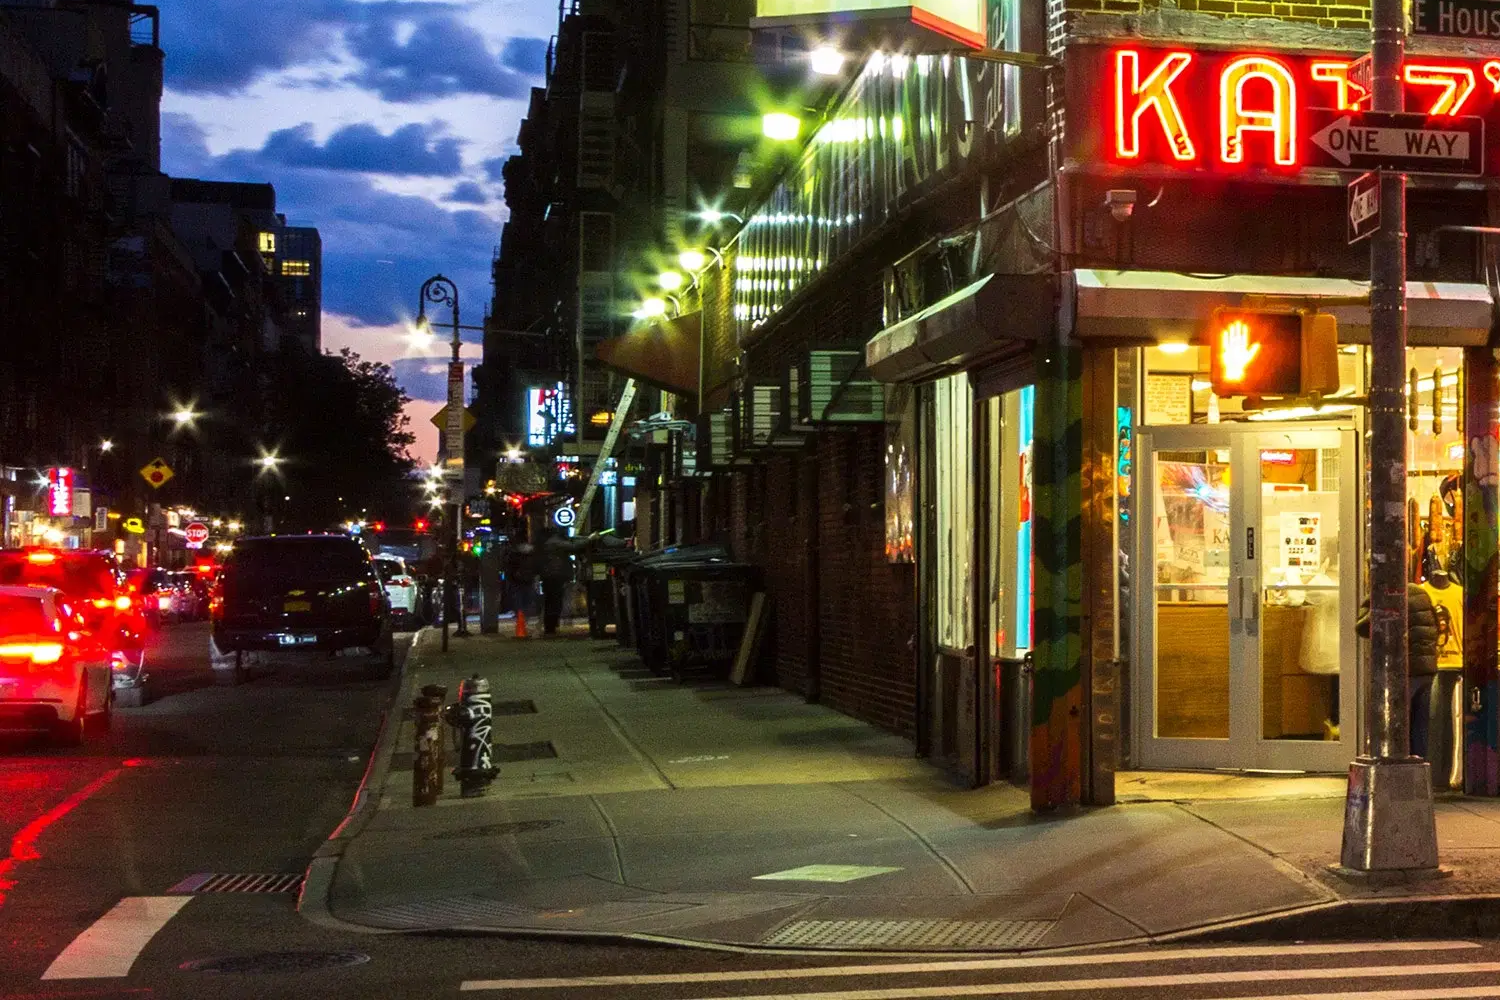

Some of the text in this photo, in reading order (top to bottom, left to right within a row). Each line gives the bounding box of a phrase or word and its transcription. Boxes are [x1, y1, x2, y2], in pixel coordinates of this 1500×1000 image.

[1414, 0, 1427, 32] E
[1328, 128, 1459, 156] ONE WAY
[187, 529, 207, 538] STOP
